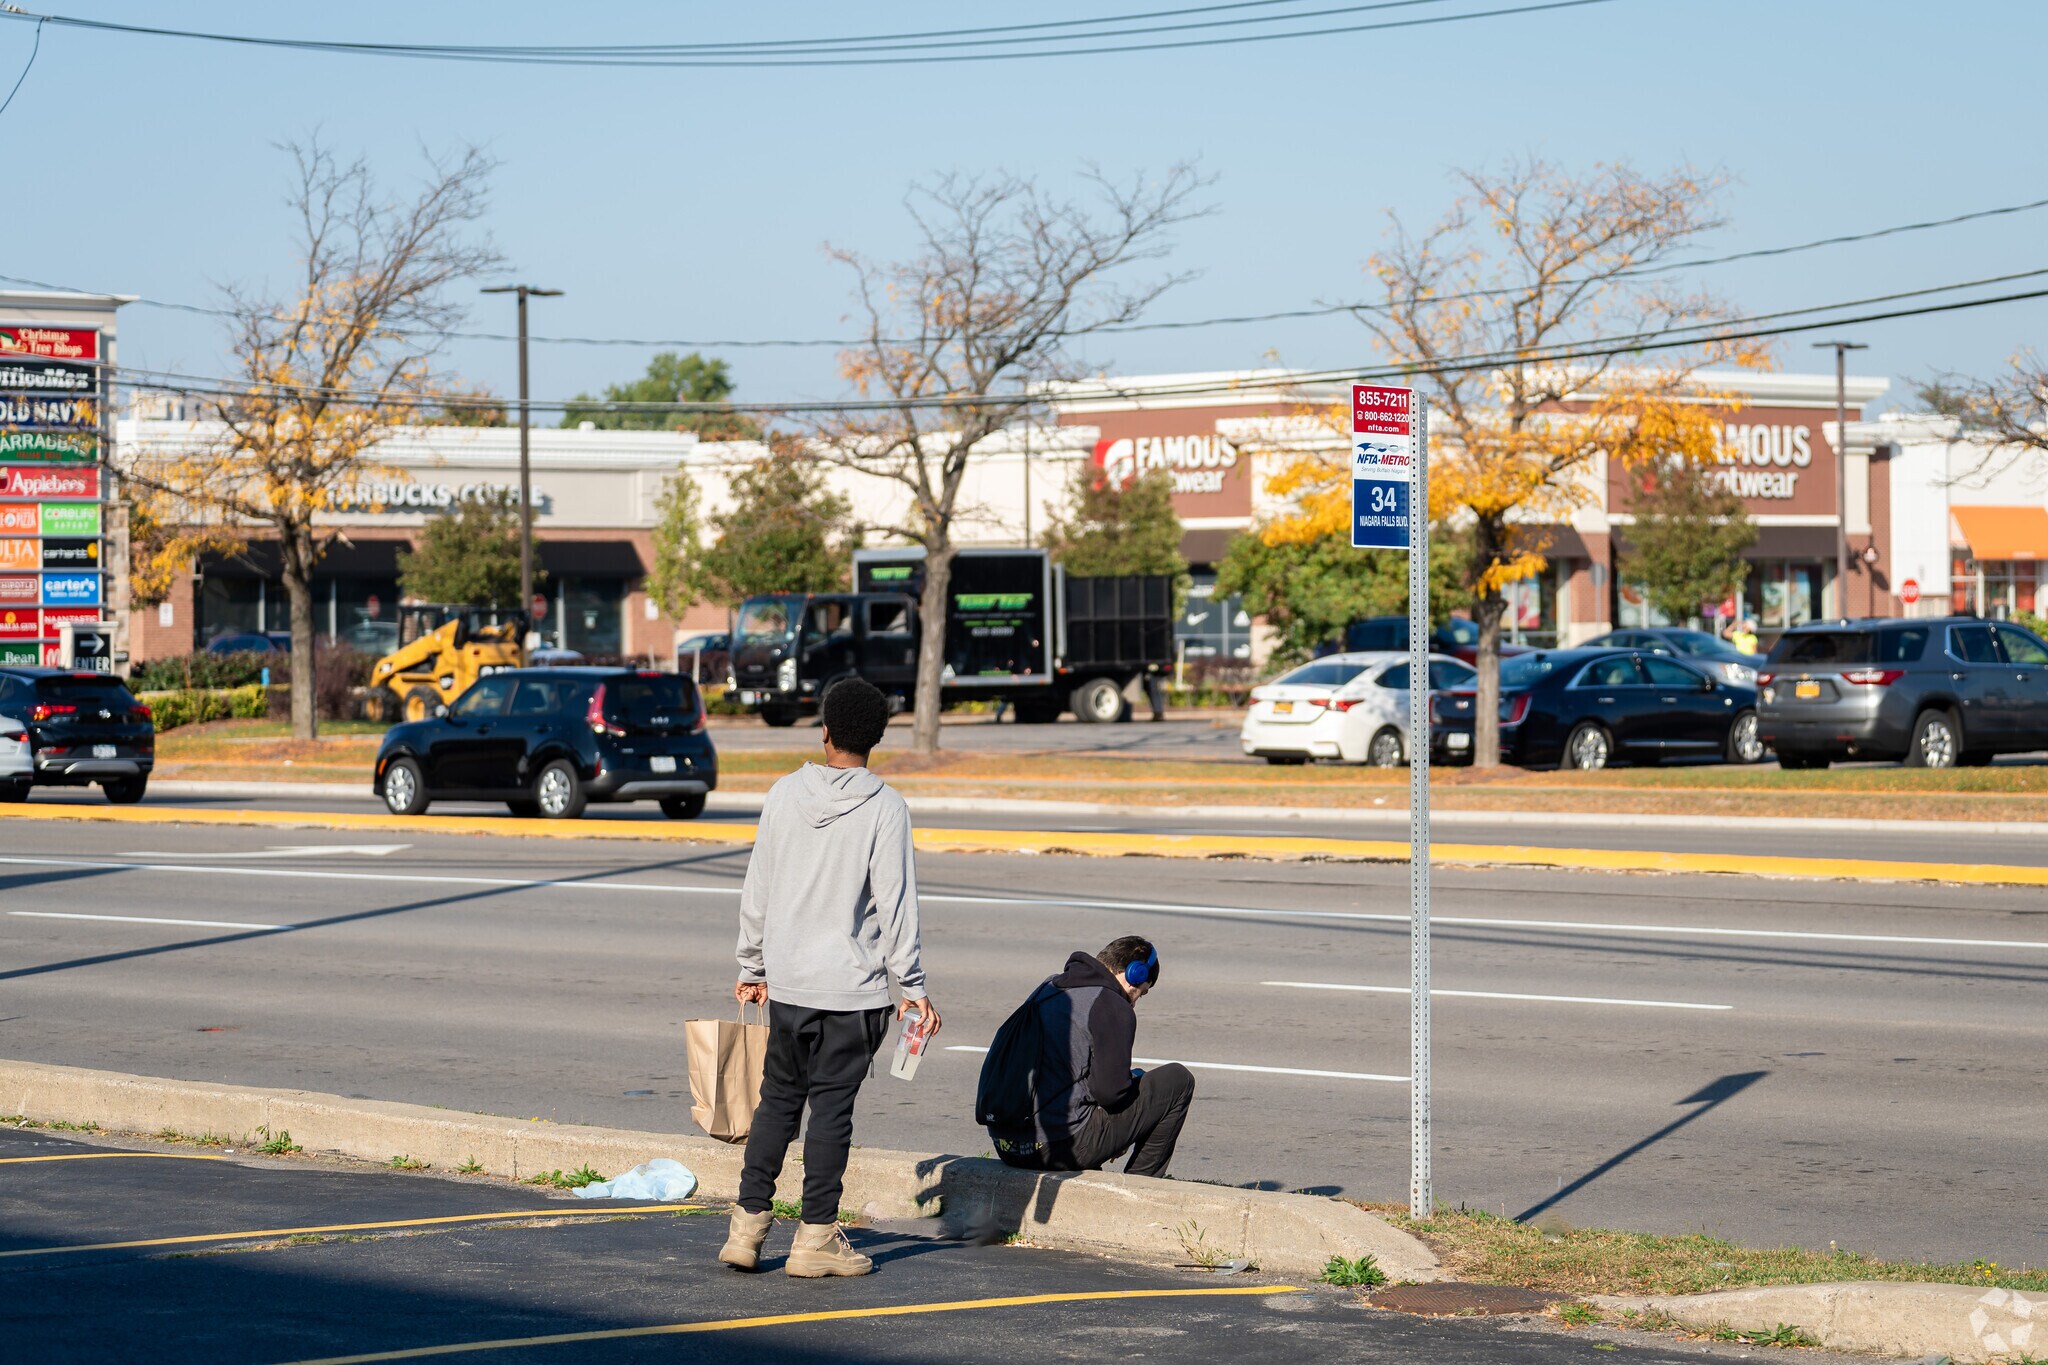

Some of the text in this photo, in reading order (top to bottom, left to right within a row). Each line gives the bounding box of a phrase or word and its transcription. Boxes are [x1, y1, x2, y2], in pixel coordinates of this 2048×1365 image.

[19, 329, 70, 343] Christmas
[30, 341, 83, 357] Tree Shops
[0, 366, 88, 388] fficeMax
[1359, 391, 1407, 408] 855-7211
[1364, 411, 1410, 423] 800-662-1220
[1367, 424, 1399, 432] nfta.com
[1135, 435, 1237, 469] FAMOUS
[1708, 424, 1812, 467] MOUS
[322, 482, 451, 506] TARBUCKS
[1371, 486, 1397, 513] 34
[1359, 515, 1380, 527] NIAGARA
[1381, 515, 1395, 527] FALLS
[0, 581, 34, 589] HIPOTLE
[44, 578, 96, 592] carter's
[75, 656, 110, 671] ENTER
